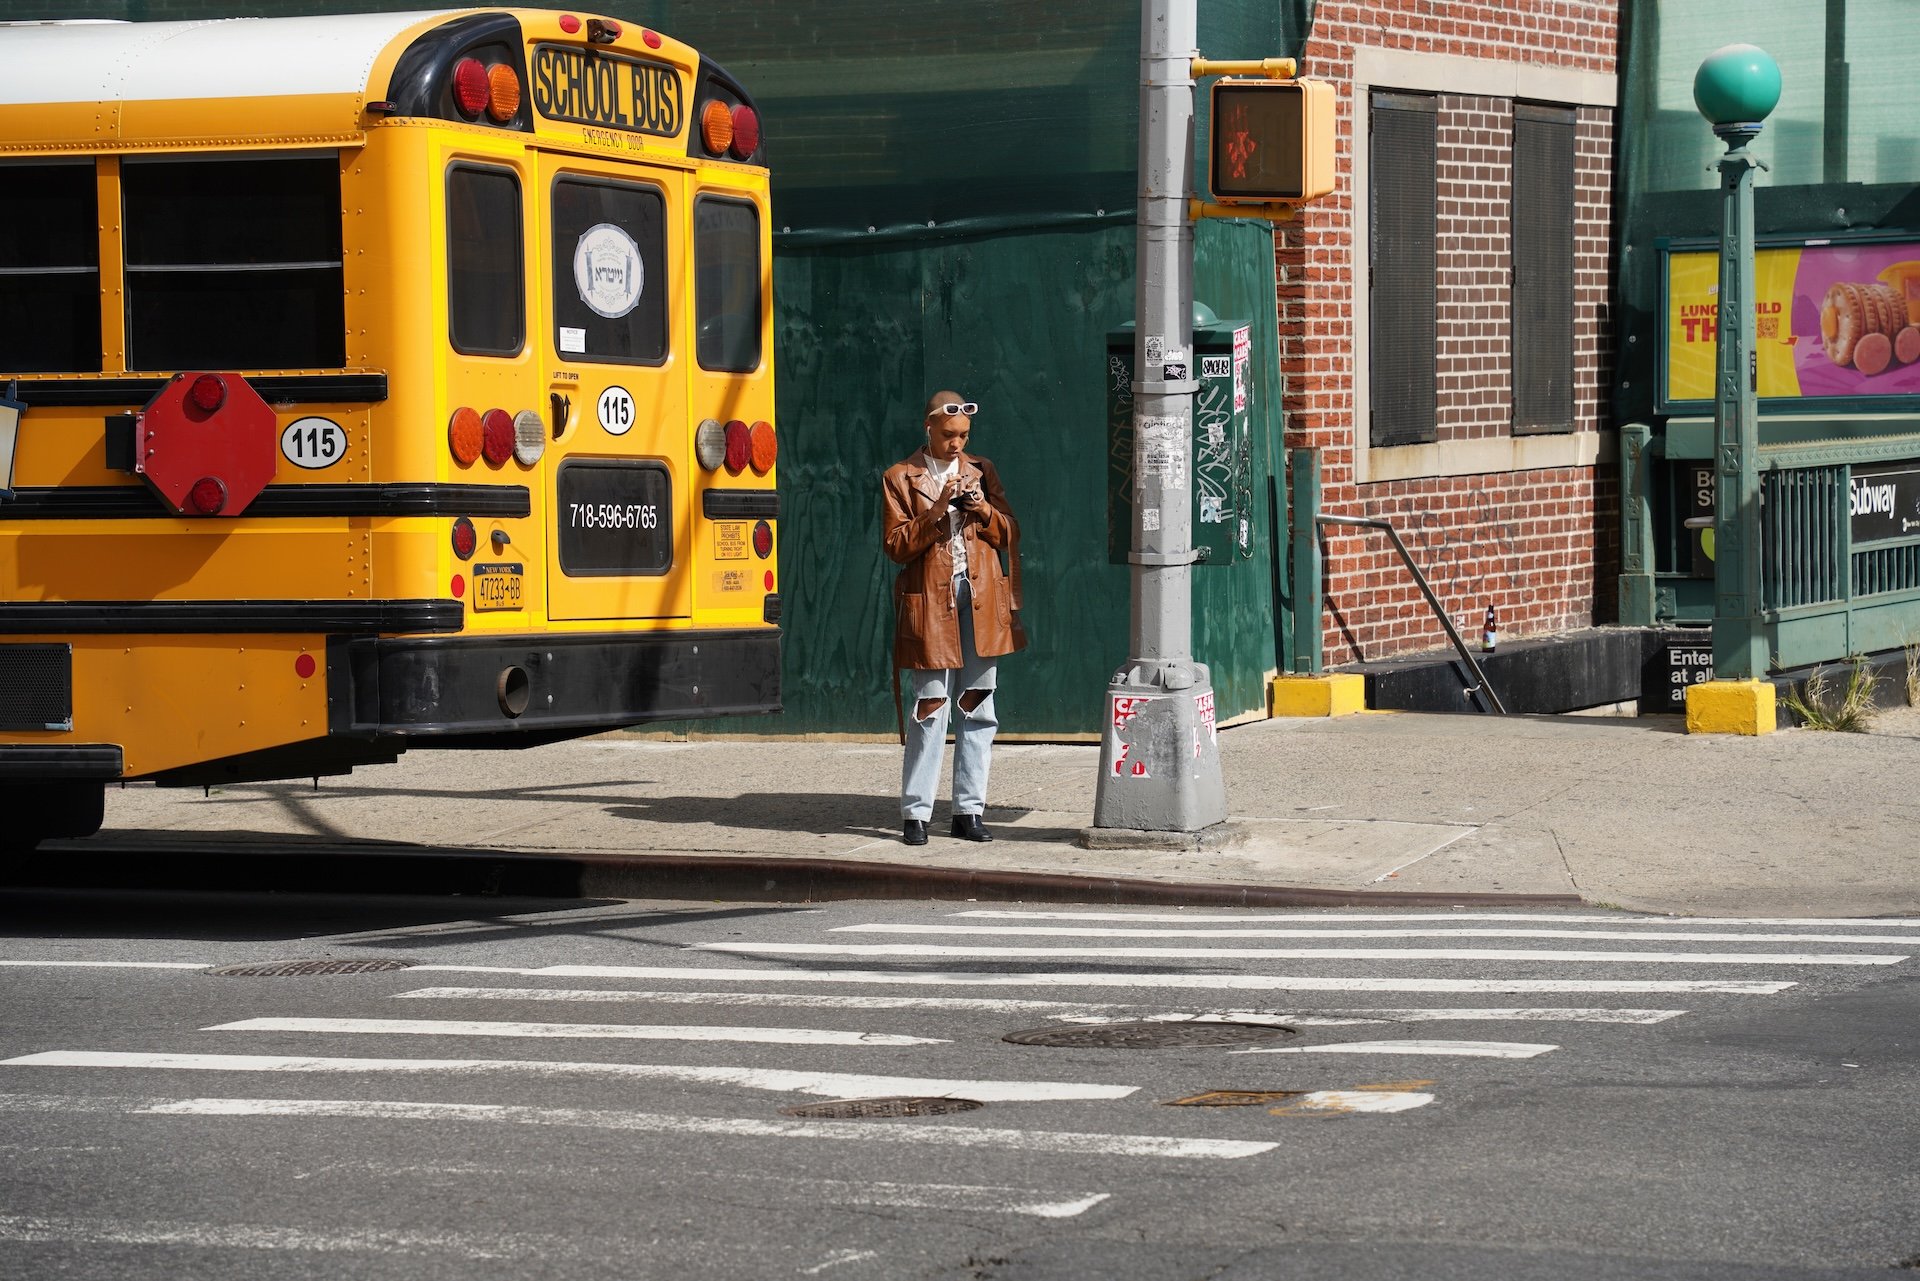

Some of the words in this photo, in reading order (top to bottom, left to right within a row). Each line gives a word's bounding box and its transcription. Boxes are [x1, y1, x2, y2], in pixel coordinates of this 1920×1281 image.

[537, 49, 627, 124] SCHOOL
[631, 64, 674, 132] BUS
[583, 128, 623, 148] EMERGENCY
[627, 134, 644, 151] DOOR
[1680, 318, 1718, 343] TH
[553, 371, 562, 379] LIFT
[568, 372, 579, 380] OPEN
[603, 396, 629, 425] 115
[292, 427, 336, 458] 115
[1850, 478, 1896, 520] Subway
[570, 503, 657, 530] 718-596-6765
[1671, 668, 1688, 683] at
